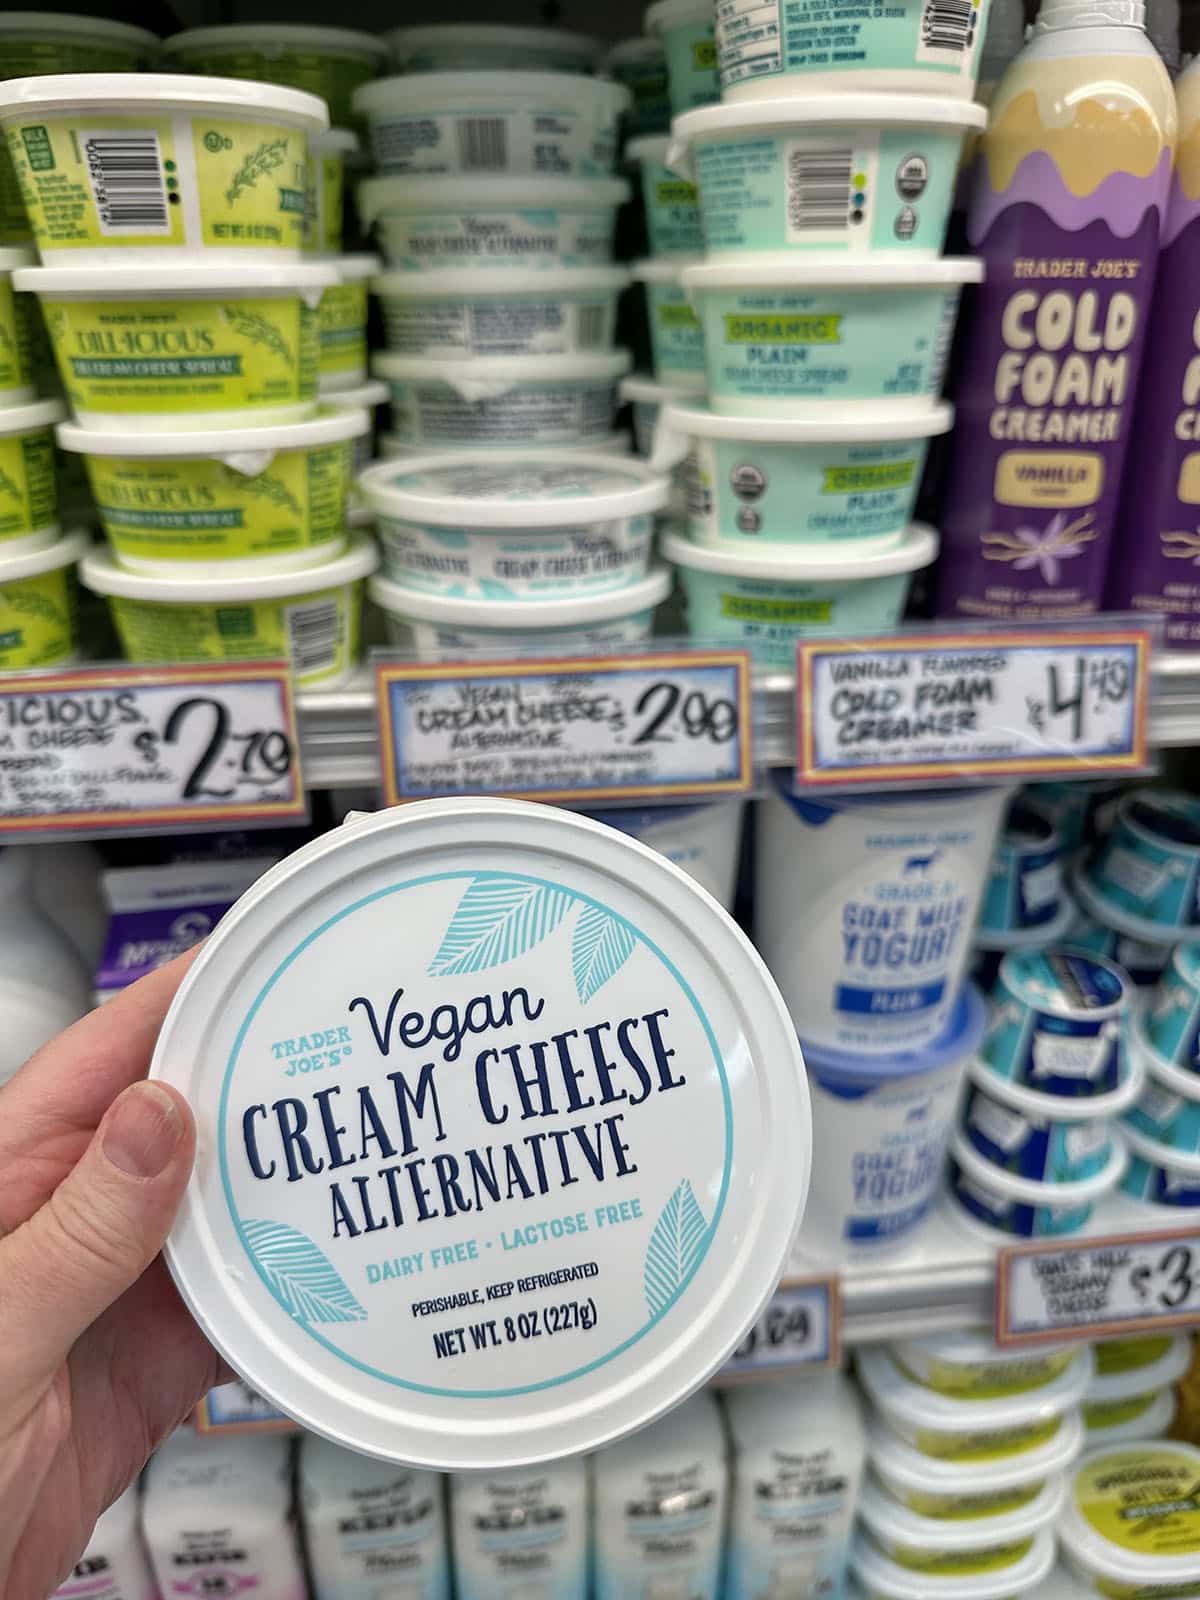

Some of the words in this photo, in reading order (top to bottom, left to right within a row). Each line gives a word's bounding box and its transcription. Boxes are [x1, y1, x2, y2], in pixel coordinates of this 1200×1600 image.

[1012, 258, 1086, 278] TRADER
[1001, 290, 1136, 351] COLD
[994, 352, 1128, 407] FOAM
[989, 408, 1120, 442] CREAMER
[0, 692, 140, 728] ICIOUS
[831, 686, 902, 722] COLD
[914, 676, 995, 711] FOAM
[841, 902, 902, 931] GOAT
[841, 920, 962, 968] YOGURT
[272, 1026, 352, 1061] TRADER
[348, 986, 544, 1063] Vegan
[241, 1062, 448, 1183] CREAM
[474, 1008, 686, 1126] CHEESE
[328, 1113, 638, 1239] ALTERNATIVE
[365, 1252, 425, 1284] DAIRY
[431, 1240, 479, 1270] FREE
[501, 1213, 589, 1252] LACTOSE
[595, 1198, 644, 1228] FREE
[411, 1288, 485, 1318] PERISHABLE,
[485, 1281, 516, 1303] KEEP
[516, 1262, 600, 1294] REFRIGERATED
[432, 1327, 466, 1359] NET
[468, 1319, 502, 1350] WT.
[505, 1318, 517, 1341] 8
[517, 1310, 542, 1339] OZ
[543, 1298, 597, 1336] (227g)
